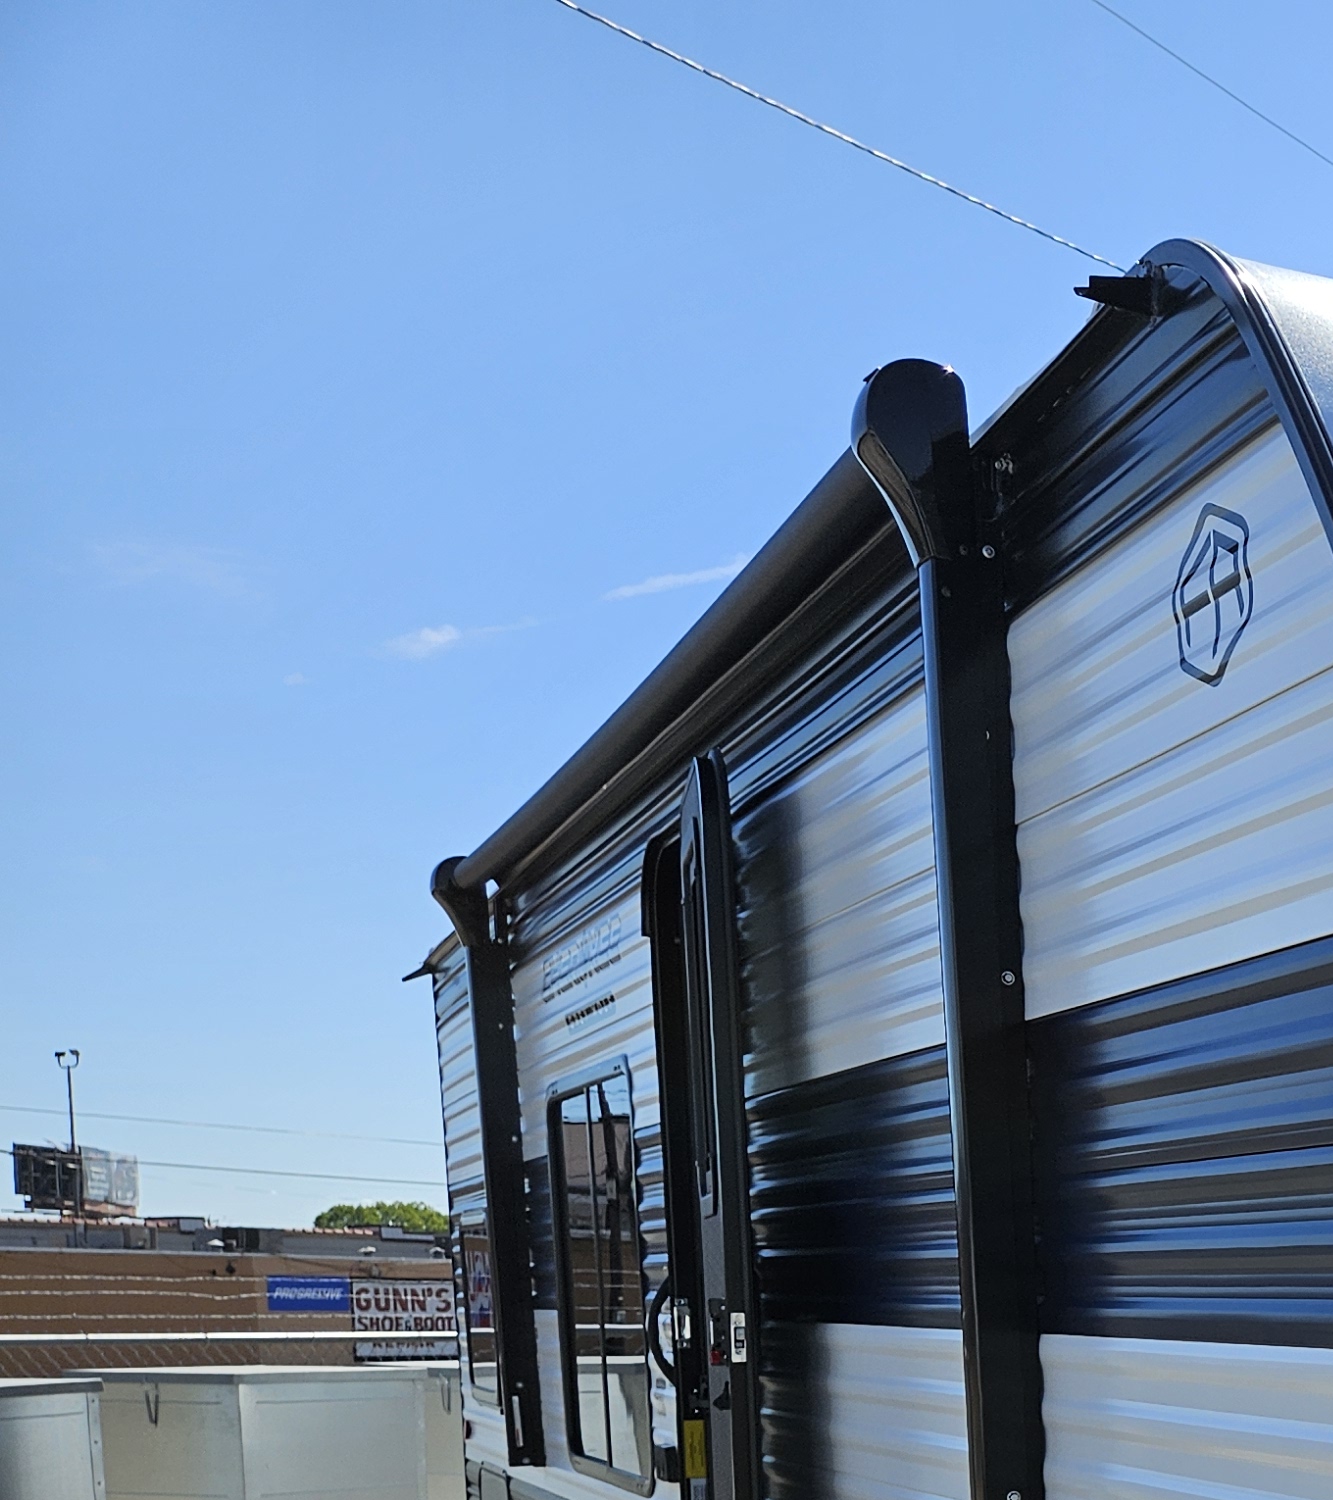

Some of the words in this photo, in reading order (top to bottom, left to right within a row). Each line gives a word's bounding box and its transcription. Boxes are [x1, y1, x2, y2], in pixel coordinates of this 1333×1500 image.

[355, 1287, 451, 1313] GUNN'S
[357, 1316, 404, 1331] SHOE
[413, 1316, 454, 1331] BOOT
